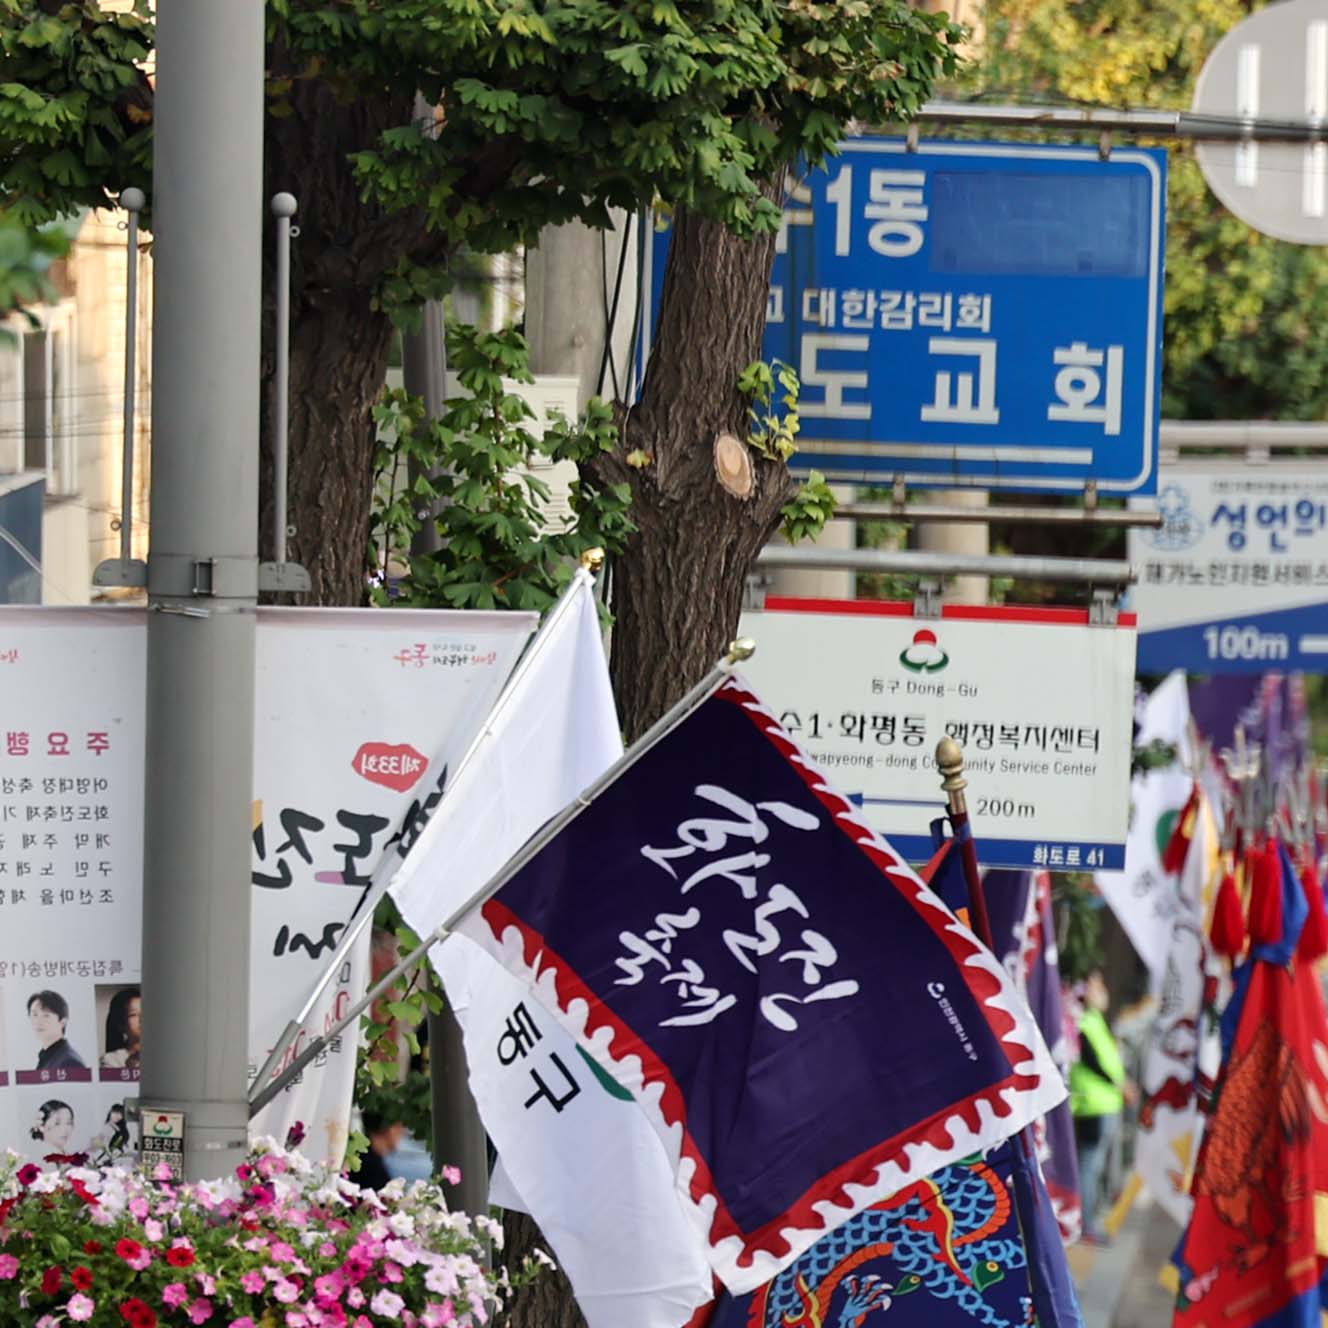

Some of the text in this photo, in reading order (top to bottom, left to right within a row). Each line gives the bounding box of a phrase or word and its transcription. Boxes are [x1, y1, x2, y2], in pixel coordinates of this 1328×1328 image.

[801, 288, 992, 333] 대한감리회
[1203, 624, 1290, 661] 100m
[871, 679, 978, 699] 동구 Dong-Gu
[944, 721, 1100, 754] 행정복지센터
[804, 750, 918, 771] wapyeong-dong
[1000, 758, 1050, 775] Service
[1053, 761, 1097, 777] Center
[976, 798, 1036, 818] 200m
[1032, 843, 1105, 867] 화도로 41
[640, 784, 860, 1032] 화도진
[613, 906, 738, 1029] 축제
[938, 997, 969, 1042] 인천광역시
[496, 1000, 582, 1114] 동구
[143, 1137, 182, 1151] 화도진로
